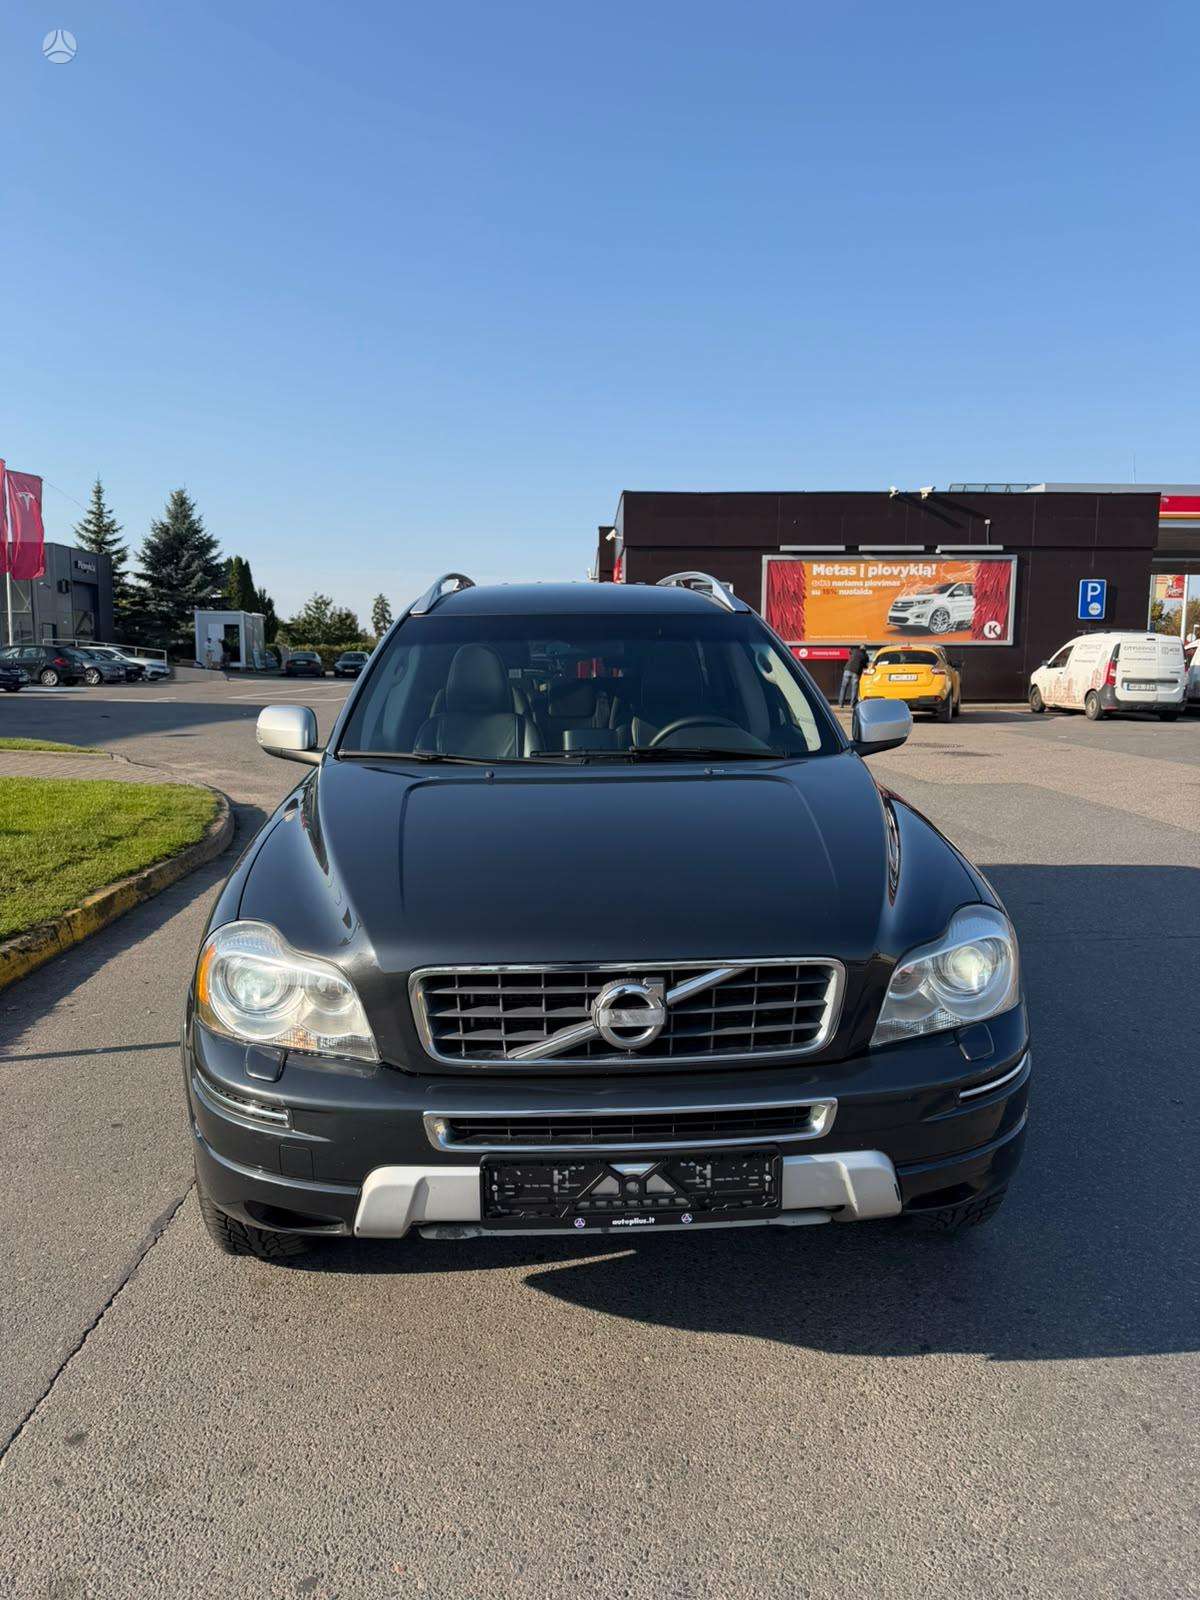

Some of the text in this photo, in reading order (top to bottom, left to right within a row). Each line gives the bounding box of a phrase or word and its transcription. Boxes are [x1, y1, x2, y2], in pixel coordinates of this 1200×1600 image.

[811, 563, 937, 578] Metas į plovyklą!
[1087, 582, 1101, 602] P
[988, 623, 998, 636] K
[611, 1217, 656, 1226] autoplius.lt
